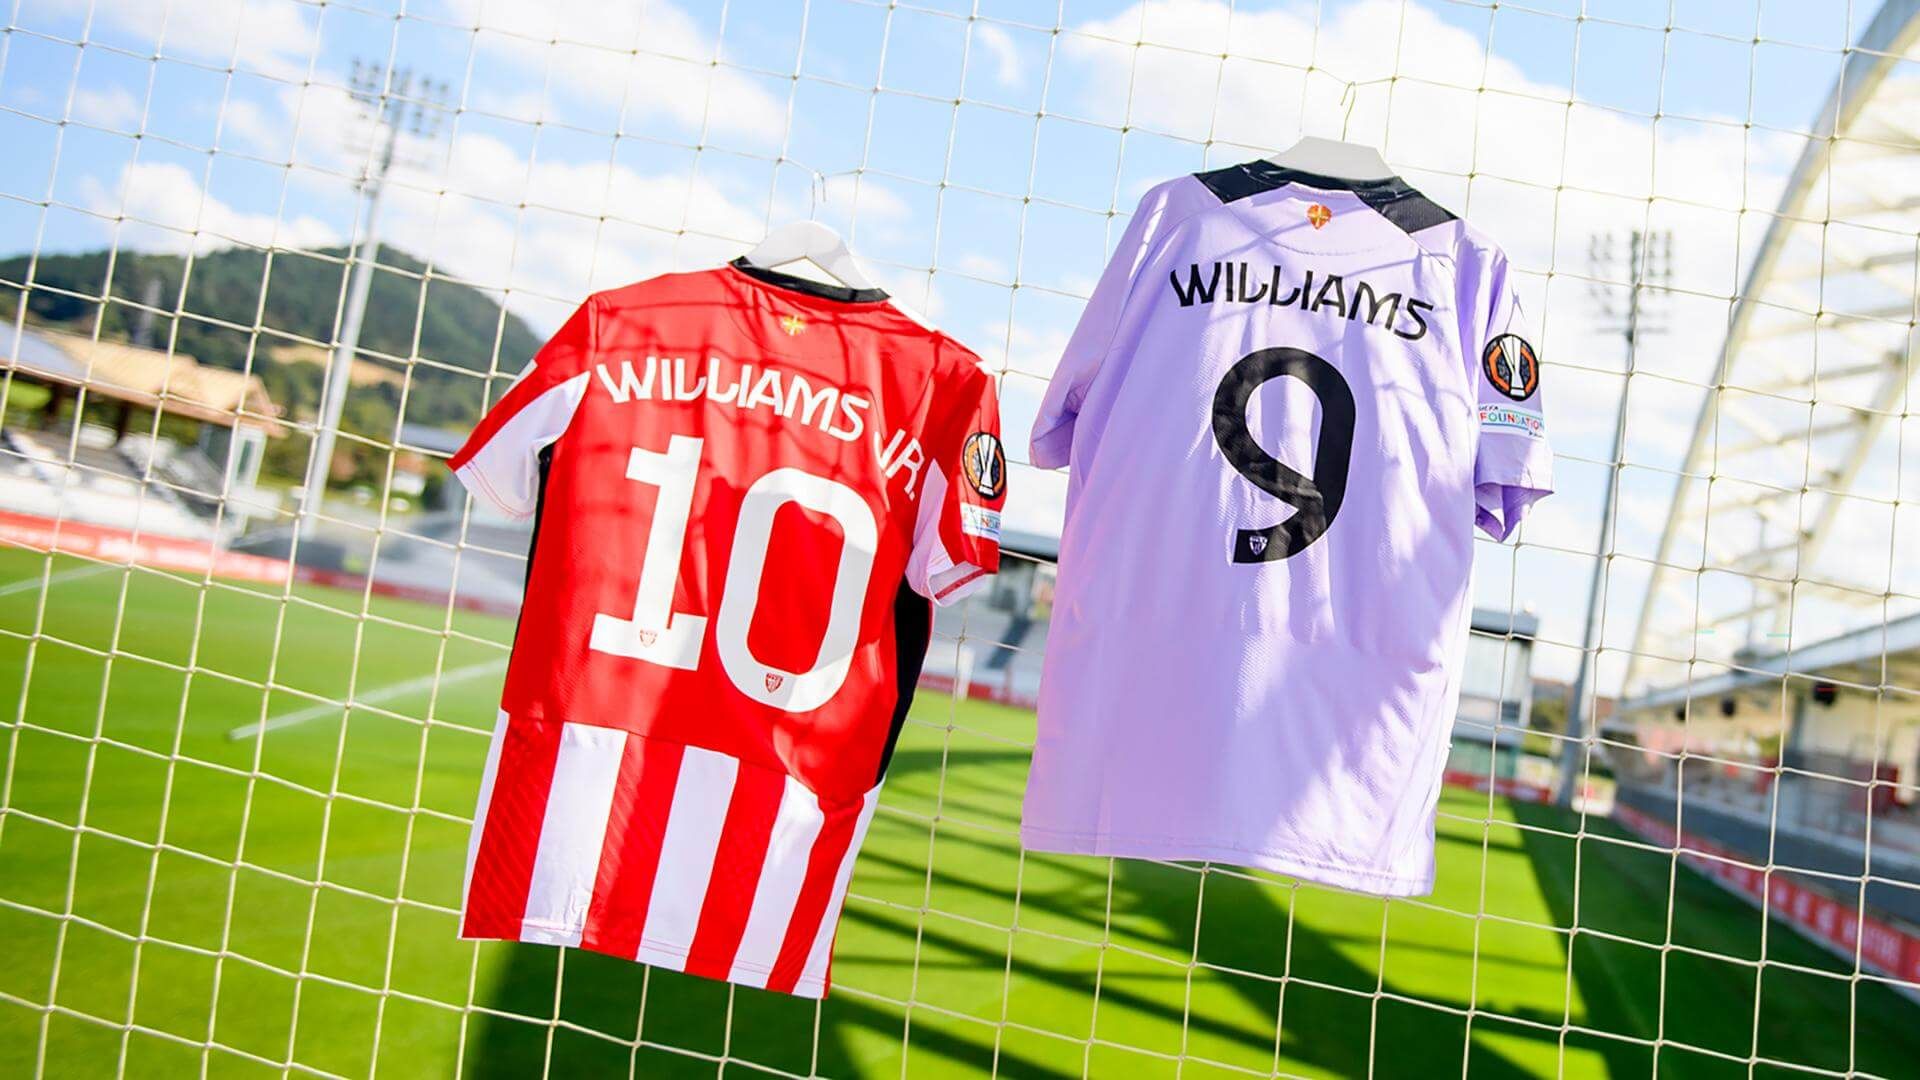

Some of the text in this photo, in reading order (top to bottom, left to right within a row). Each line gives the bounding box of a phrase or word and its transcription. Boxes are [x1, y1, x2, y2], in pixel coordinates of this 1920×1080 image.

[1169, 262, 1434, 341] WILLIAMS
[596, 356, 927, 500] WILLIAMS JR.
[1211, 346, 1356, 565] 9
[588, 433, 878, 713] 10
